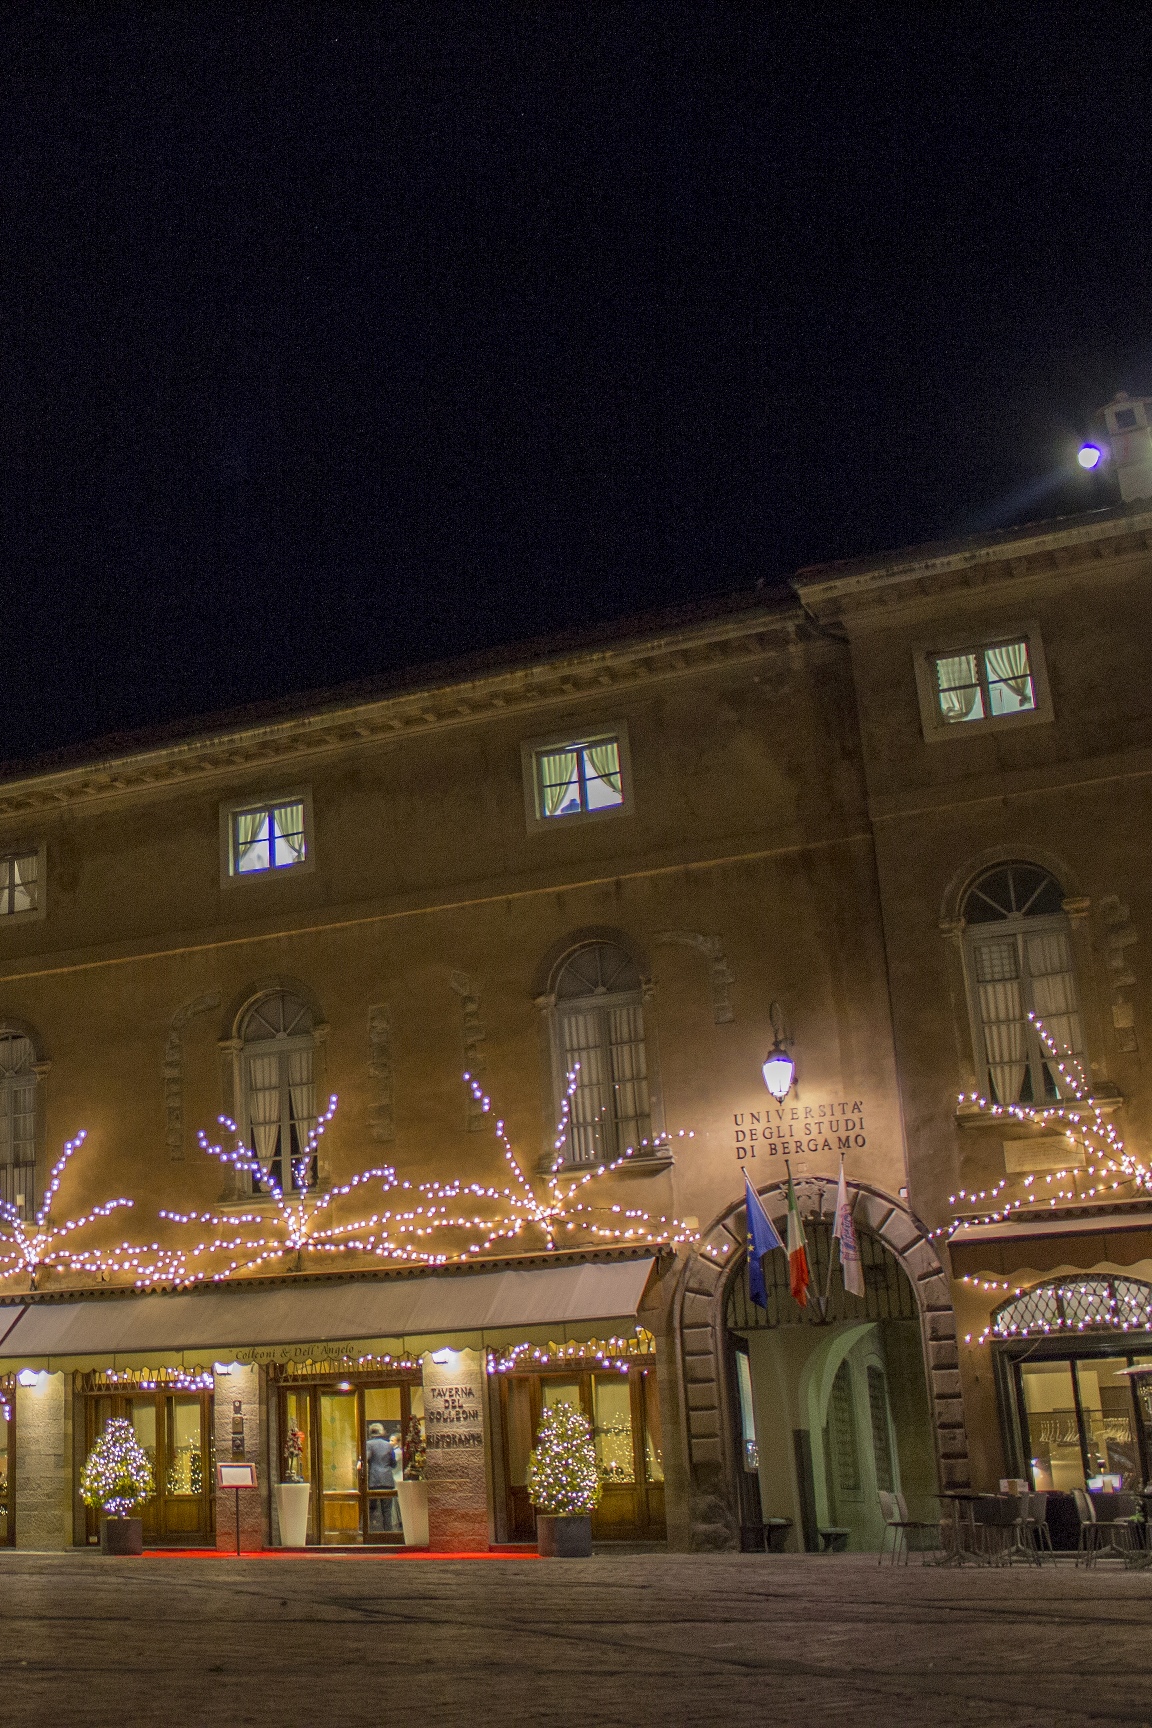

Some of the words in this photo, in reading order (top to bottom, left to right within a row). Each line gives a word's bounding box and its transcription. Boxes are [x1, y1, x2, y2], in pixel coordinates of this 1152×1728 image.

[735, 1124, 794, 1143] DEGLI
[804, 1117, 865, 1136] STUDI
[736, 1144, 756, 1160] DI
[769, 1134, 866, 1156] BERGAMO
[236, 1347, 276, 1360] Colleoni
[431, 1386, 475, 1399] TAVERNA
[444, 1399, 463, 1410] DEL
[428, 1409, 478, 1423] COLLEONI
